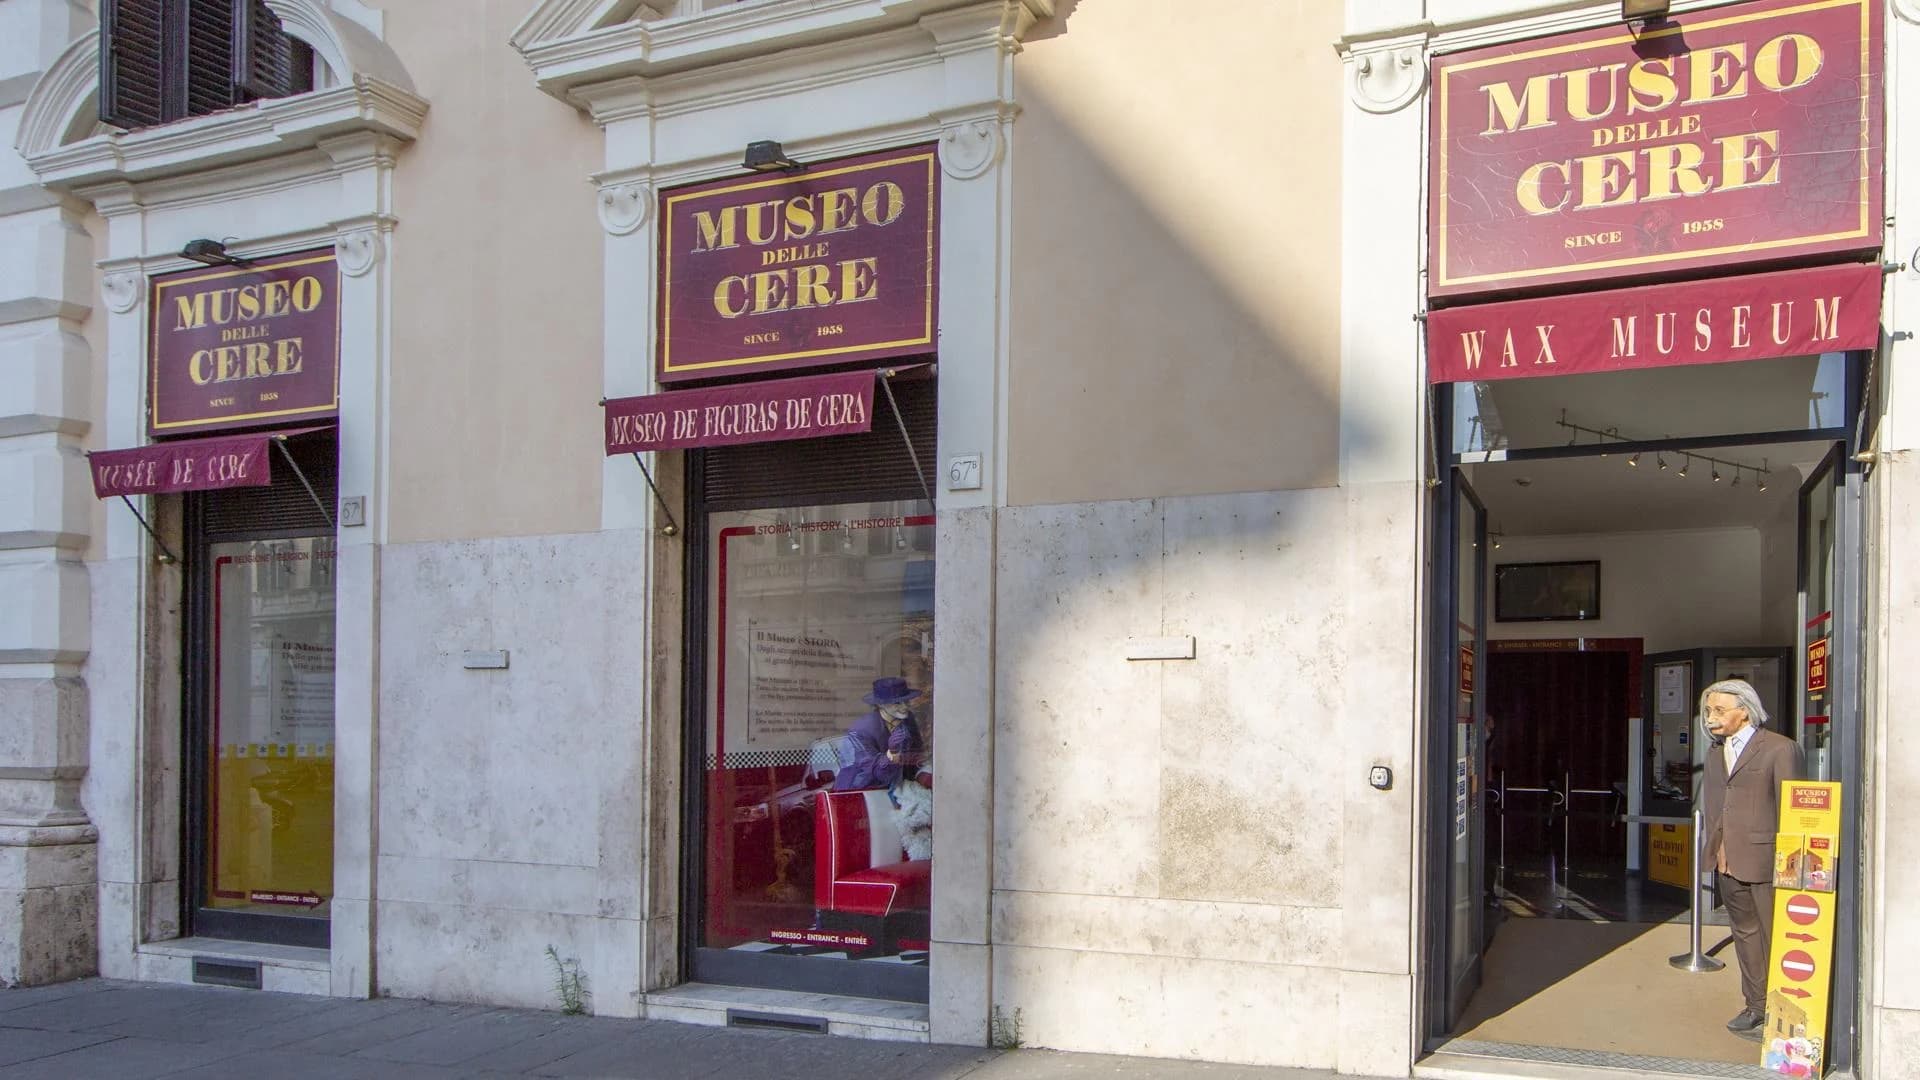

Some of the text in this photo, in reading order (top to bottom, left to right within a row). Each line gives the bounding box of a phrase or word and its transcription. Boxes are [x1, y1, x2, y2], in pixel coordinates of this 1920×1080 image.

[1479, 32, 1825, 136] MUSEO
[1591, 113, 1701, 148] DELLE
[1516, 129, 1782, 216] CERE
[690, 181, 906, 254] MUSEO
[1564, 217, 1724, 249] SINCE 1958
[761, 241, 830, 266] DELLE
[172, 275, 323, 332] MUSEO
[713, 257, 879, 319] CERE
[222, 324, 270, 342] DELLE
[743, 324, 843, 345] SINCE 1958
[1460, 296, 1842, 370] WAX MUSEUM
[188, 337, 303, 386] CERE
[209, 397, 235, 408] SINCE
[610, 391, 866, 446] MUSEO DE FIGURAS DE CERA
[173, 458, 194, 484] DE
[758, 517, 901, 535] STORIA HISTORY L'HISTOIRE
[803, 637, 840, 649] STORIA
[1795, 789, 1827, 797] MUSEO
[771, 930, 868, 945] INGRESSO ENTRANCE ENTRÉE
